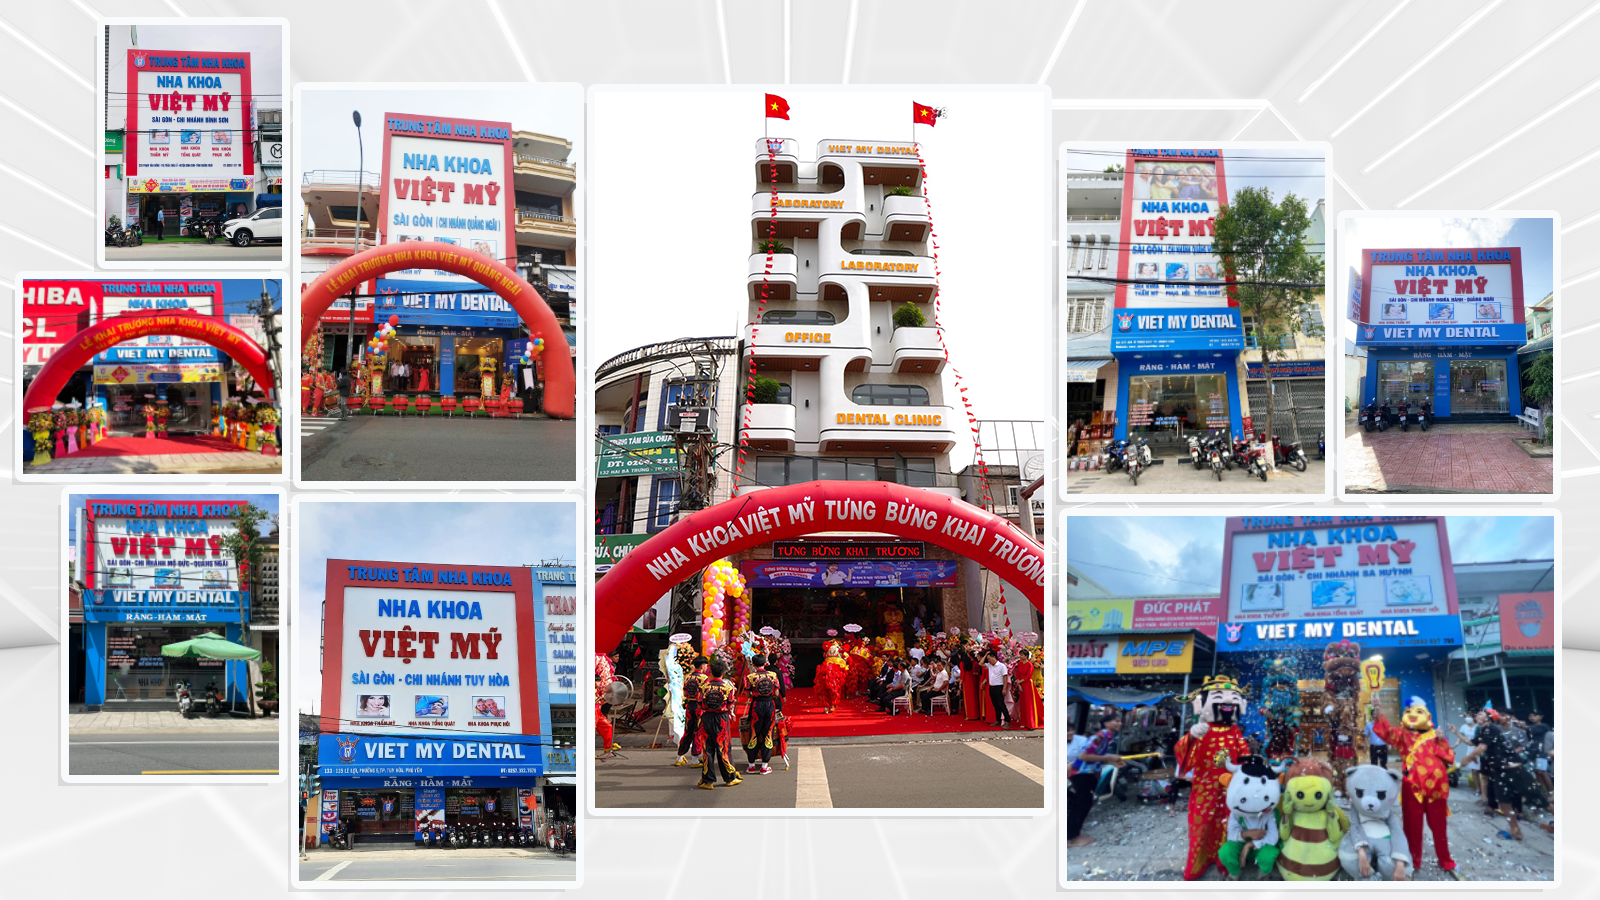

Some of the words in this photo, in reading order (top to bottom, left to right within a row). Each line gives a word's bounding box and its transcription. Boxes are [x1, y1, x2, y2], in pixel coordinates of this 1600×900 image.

[149, 57, 178, 67] TRUNG
[181, 55, 199, 68] TÂM
[202, 58, 220, 68] NHA
[222, 58, 245, 68] KHOA
[157, 76, 183, 88] NHA
[188, 76, 222, 88] KHOA
[149, 91, 196, 114] VIỆT
[203, 92, 231, 112] MỸ
[388, 118, 424, 133] TRUNG
[426, 120, 452, 135] TÂM
[455, 124, 477, 137] NHA
[480, 126, 509, 140] KHOA
[828, 145, 852, 153] VIET
[856, 146, 873, 154] MY
[877, 146, 919, 155] DENTAL
[1197, 150, 1219, 158] KHOA
[403, 152, 439, 171] NHA
[444, 155, 492, 175] KHOA
[394, 176, 455, 206] VIỆT
[463, 181, 500, 206] MỸ
[770, 199, 844, 209] LABORATORY
[1142, 202, 1169, 213] NHA
[1172, 202, 1209, 213] KHOA
[393, 212, 409, 226] SÀI
[412, 213, 433, 227] GÒN
[1134, 216, 1184, 240] VIỆT
[1370, 251, 1412, 262] TRUNG
[1416, 249, 1444, 262] TÂM
[1448, 250, 1473, 261] NHA
[1477, 250, 1511, 261] KHOA
[337, 267, 359, 285] KHAI
[394, 251, 412, 262] NHA
[414, 250, 437, 260] KHOA
[473, 262, 502, 282] QUẢNG
[841, 260, 919, 272] LABORATORY
[1406, 266, 1435, 276] NHA
[1438, 265, 1477, 276] KHOA
[102, 284, 136, 293] TRUNG
[139, 283, 161, 293] TÂM
[163, 284, 185, 293] NHA
[188, 284, 216, 293] KHOA
[1394, 276, 1448, 297] VIỆT
[1455, 276, 1487, 294] MỸ
[128, 299, 152, 308] NHA
[156, 299, 188, 308] KHOA
[402, 291, 431, 309] VIET
[435, 294, 457, 310] MY
[461, 294, 512, 312] DENTAL
[1138, 316, 1165, 330] VIET
[1168, 315, 1188, 330] MY
[1191, 314, 1237, 329] DENTAL
[93, 327, 116, 344] KHAI
[156, 316, 176, 325] NHA
[179, 318, 203, 328] KHOA
[1383, 328, 1414, 339] VIET
[1419, 328, 1442, 339] MY
[1446, 327, 1499, 338] DENTAL
[785, 332, 831, 343] OFFICE
[117, 349, 142, 358] VIET
[147, 349, 166, 358] MY
[169, 348, 213, 358] DENTAL
[1140, 363, 1163, 371] RĂNG
[1171, 362, 1190, 370] HÀM
[1198, 362, 1215, 371] MẶT
[836, 413, 890, 425] DENTAL
[894, 414, 942, 426] CLINIC
[628, 436, 641, 445] TÂM
[92, 503, 136, 516] TRUNG
[140, 502, 168, 516] TÂM
[171, 504, 198, 516] NHA
[126, 520, 158, 533] NHA
[165, 520, 208, 534] KHOA
[645, 546, 690, 581] NHA
[687, 520, 741, 556] KHOA
[739, 506, 781, 537] VIỆT
[788, 496, 815, 525] MỸ
[824, 498, 876, 520] TƯNG
[885, 497, 938, 530] BỪNG
[941, 515, 986, 546] KHAI
[1268, 530, 1316, 548] NHA
[1328, 525, 1397, 544] KHOA
[110, 533, 175, 559] VIỆT
[185, 535, 224, 556] MỸ
[778, 545, 806, 556] TƯNG
[812, 545, 841, 556] BỪNG
[846, 547, 869, 556] KHAI
[875, 546, 920, 556] TRƯƠNG
[1252, 545, 1342, 573] VIỆT
[1357, 539, 1416, 566] MỸ
[348, 566, 398, 582] TRUNG
[402, 566, 433, 583] TÂM
[438, 571, 468, 584] NHA
[472, 571, 512, 586] KHOA
[536, 571, 565, 581] TRANG
[1258, 574, 1273, 583] SÀI
[1275, 573, 1295, 582] GÒN
[1306, 572, 1324, 580] CHI
[1325, 570, 1359, 579] NHÁNH
[1362, 570, 1376, 578] SA
[1379, 568, 1412, 576] HUỲNH
[113, 590, 145, 603] VIET
[148, 590, 173, 603] MY
[176, 591, 234, 604] DENTAL
[378, 598, 421, 618] NHA
[428, 600, 482, 620] KHOA
[1143, 601, 1174, 614] ĐỨC
[1175, 600, 1211, 613] PHÁT
[1256, 623, 1297, 639] VIET
[1304, 622, 1334, 638] MY
[1343, 620, 1419, 636] DENTAL
[359, 625, 439, 664] VIỆT
[450, 627, 502, 659] MỸ
[1121, 640, 1188, 656] MPE
[352, 670, 369, 685] SÀI
[373, 671, 394, 686] GÒN
[405, 674, 422, 686] CHI
[426, 672, 462, 686] NHÁNH
[465, 674, 484, 686] TUY
[489, 673, 510, 687] HÒA
[365, 743, 408, 759] VIET
[416, 743, 446, 759] MY
[453, 743, 525, 759] DENTAL
[546, 749, 570, 764] TRÀ
[384, 778, 413, 787] RĂNG
[421, 778, 444, 787] HÀM
[452, 779, 473, 788] MẶT
